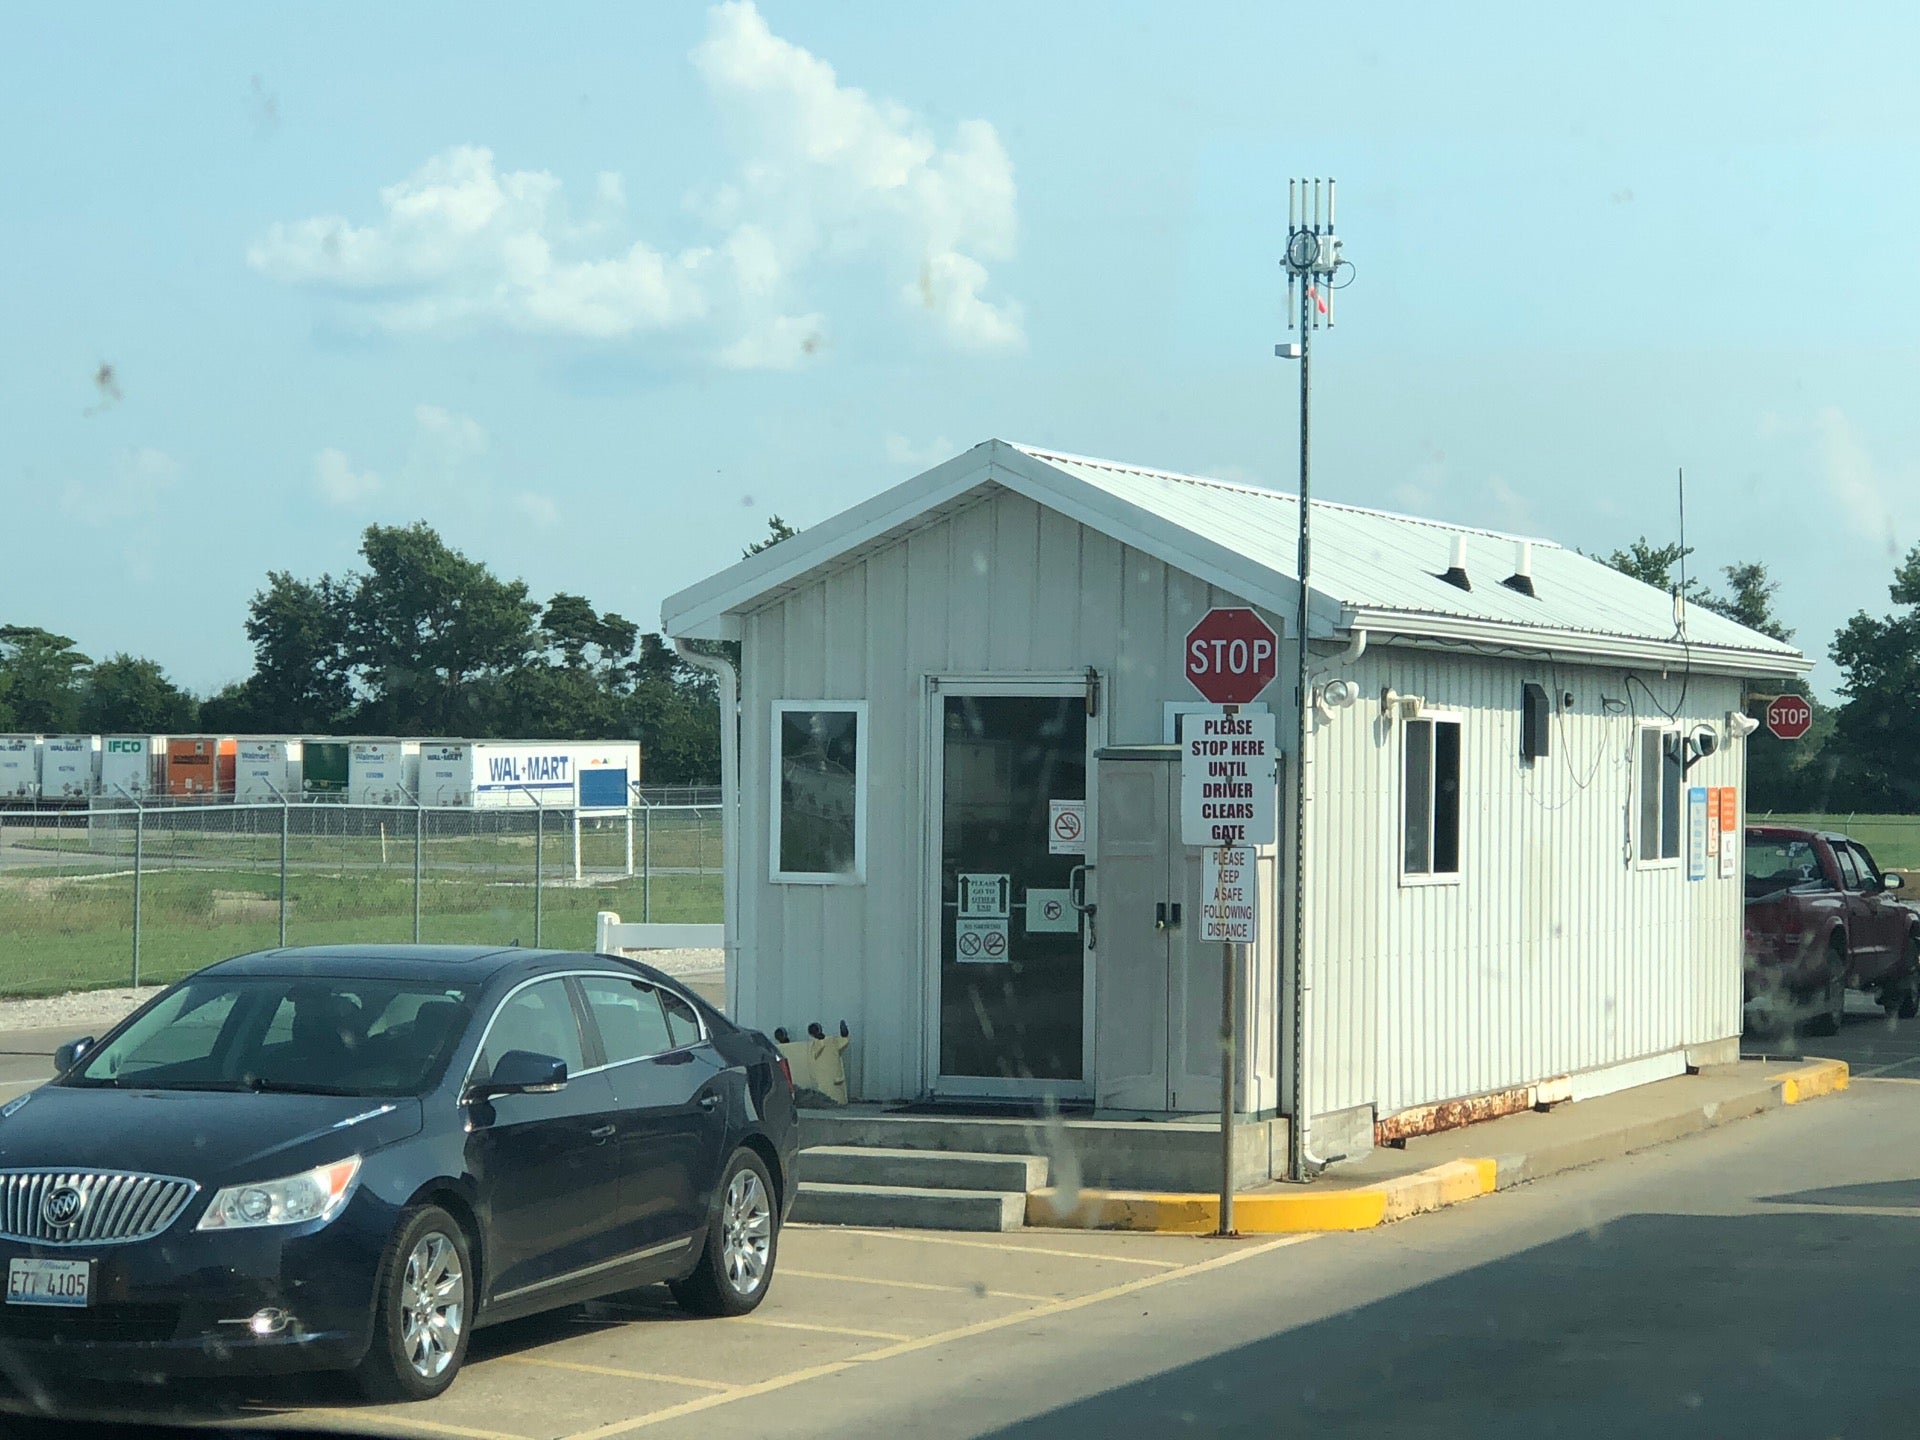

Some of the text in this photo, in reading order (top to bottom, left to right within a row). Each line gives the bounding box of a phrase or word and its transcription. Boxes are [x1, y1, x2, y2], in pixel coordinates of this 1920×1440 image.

[1190, 639, 1272, 674] STOP
[1770, 708, 1809, 725] STOP
[1204, 719, 1253, 735] PLEASE
[108, 740, 141, 753] IFCO
[1191, 740, 1265, 756] STOP HERE
[1208, 761, 1248, 777] UNTIL
[1202, 782, 1253, 798] DRIVER
[1202, 803, 1254, 819] CLEARS
[1211, 824, 1245, 840] GATE
[1212, 851, 1245, 866] PLEASE
[1218, 869, 1240, 884] KEEP
[1214, 887, 1243, 901] A SAFE
[1203, 904, 1252, 920] FOLLOWING
[1207, 922, 1248, 938] DISTANCE
[47, 1272, 86, 1297] 4105
